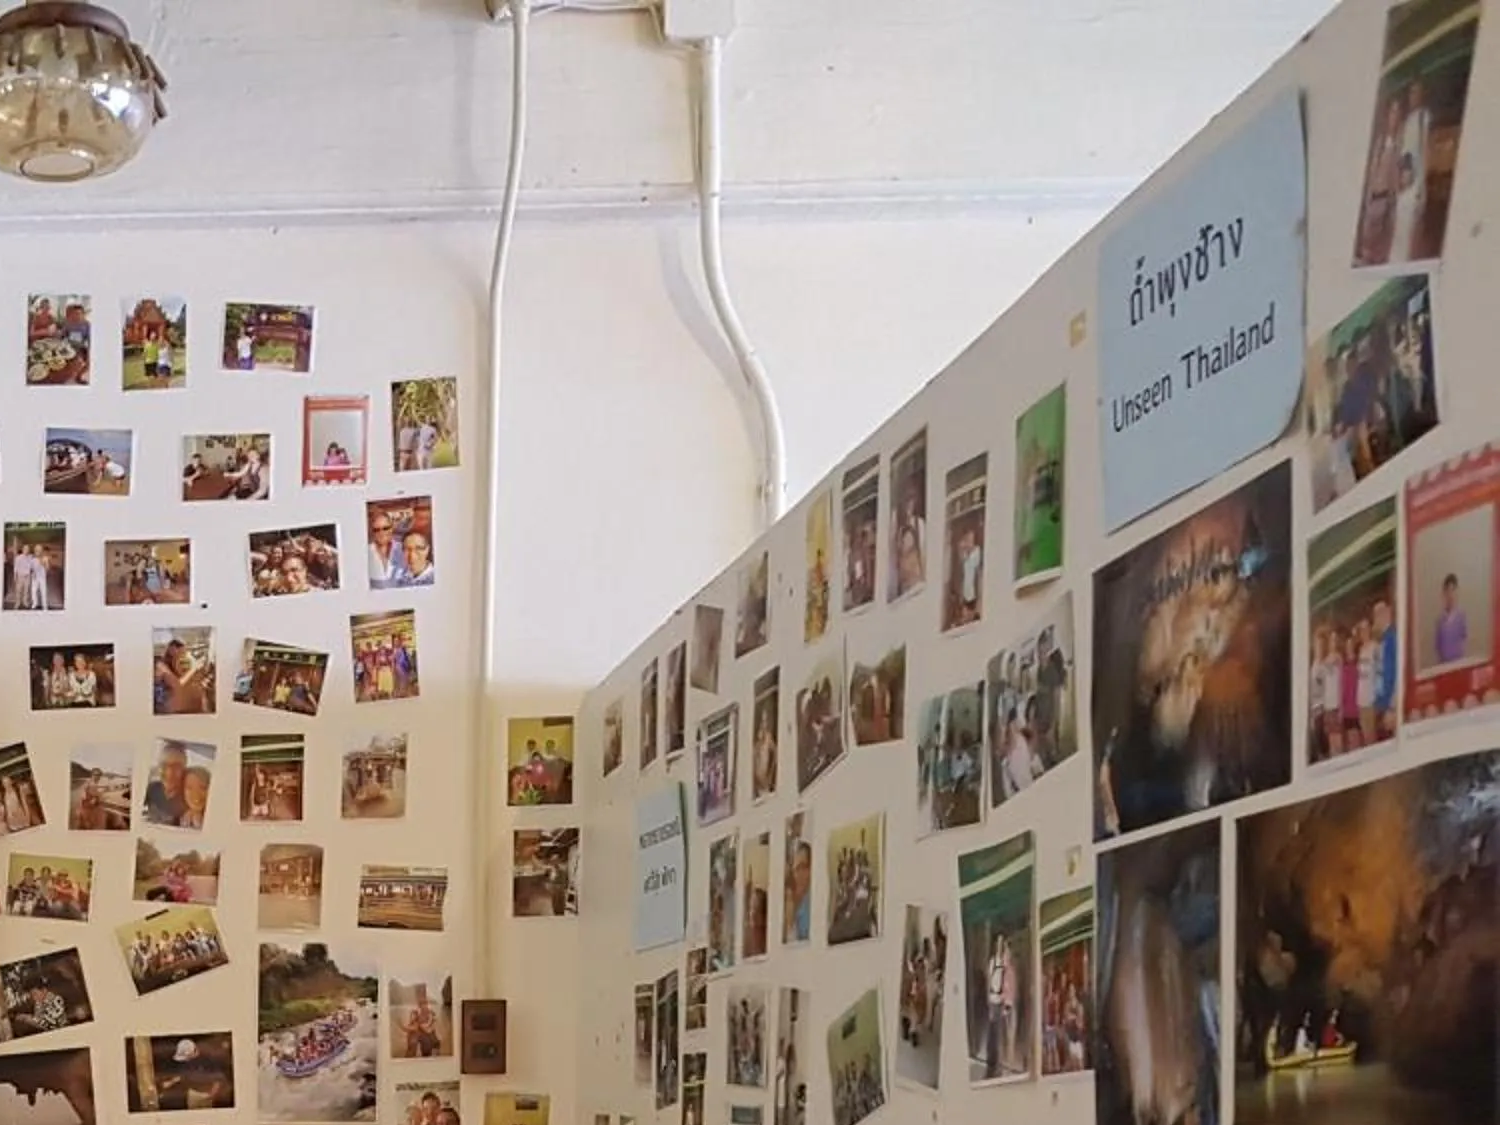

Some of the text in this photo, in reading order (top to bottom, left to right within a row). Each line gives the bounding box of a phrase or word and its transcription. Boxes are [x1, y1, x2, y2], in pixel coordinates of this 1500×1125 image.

[1129, 215, 1244, 327] ถ้ำพุงช้าง
[1111, 301, 1277, 433] Unseen Thailand
